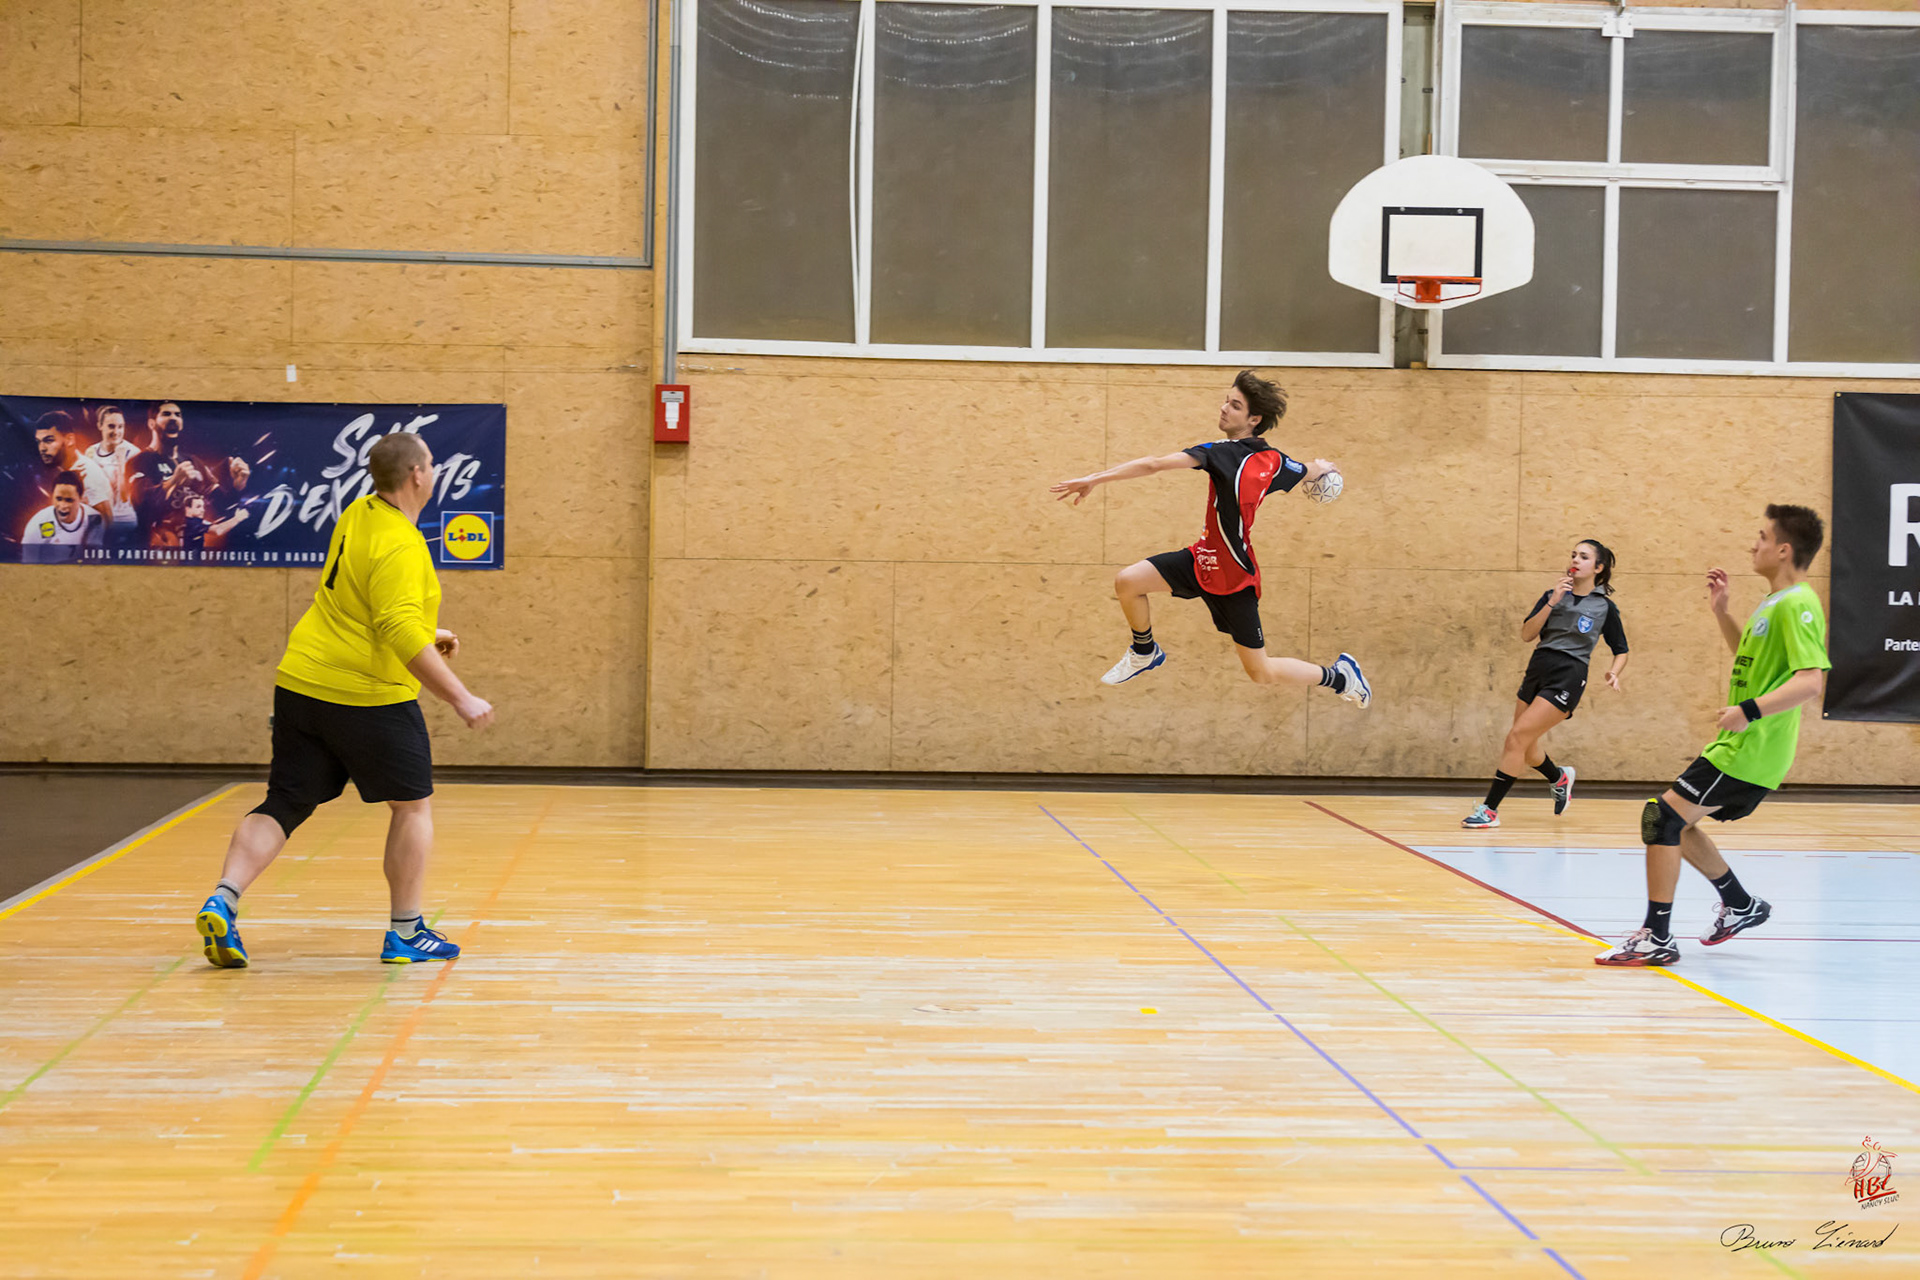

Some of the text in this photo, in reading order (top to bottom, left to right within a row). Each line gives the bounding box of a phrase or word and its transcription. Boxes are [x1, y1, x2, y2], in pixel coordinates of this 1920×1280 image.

[84, 549, 325, 562] LIDL PARTENAIRE OFFICIEL DU HANDB
[1888, 591, 1914, 606] LA
